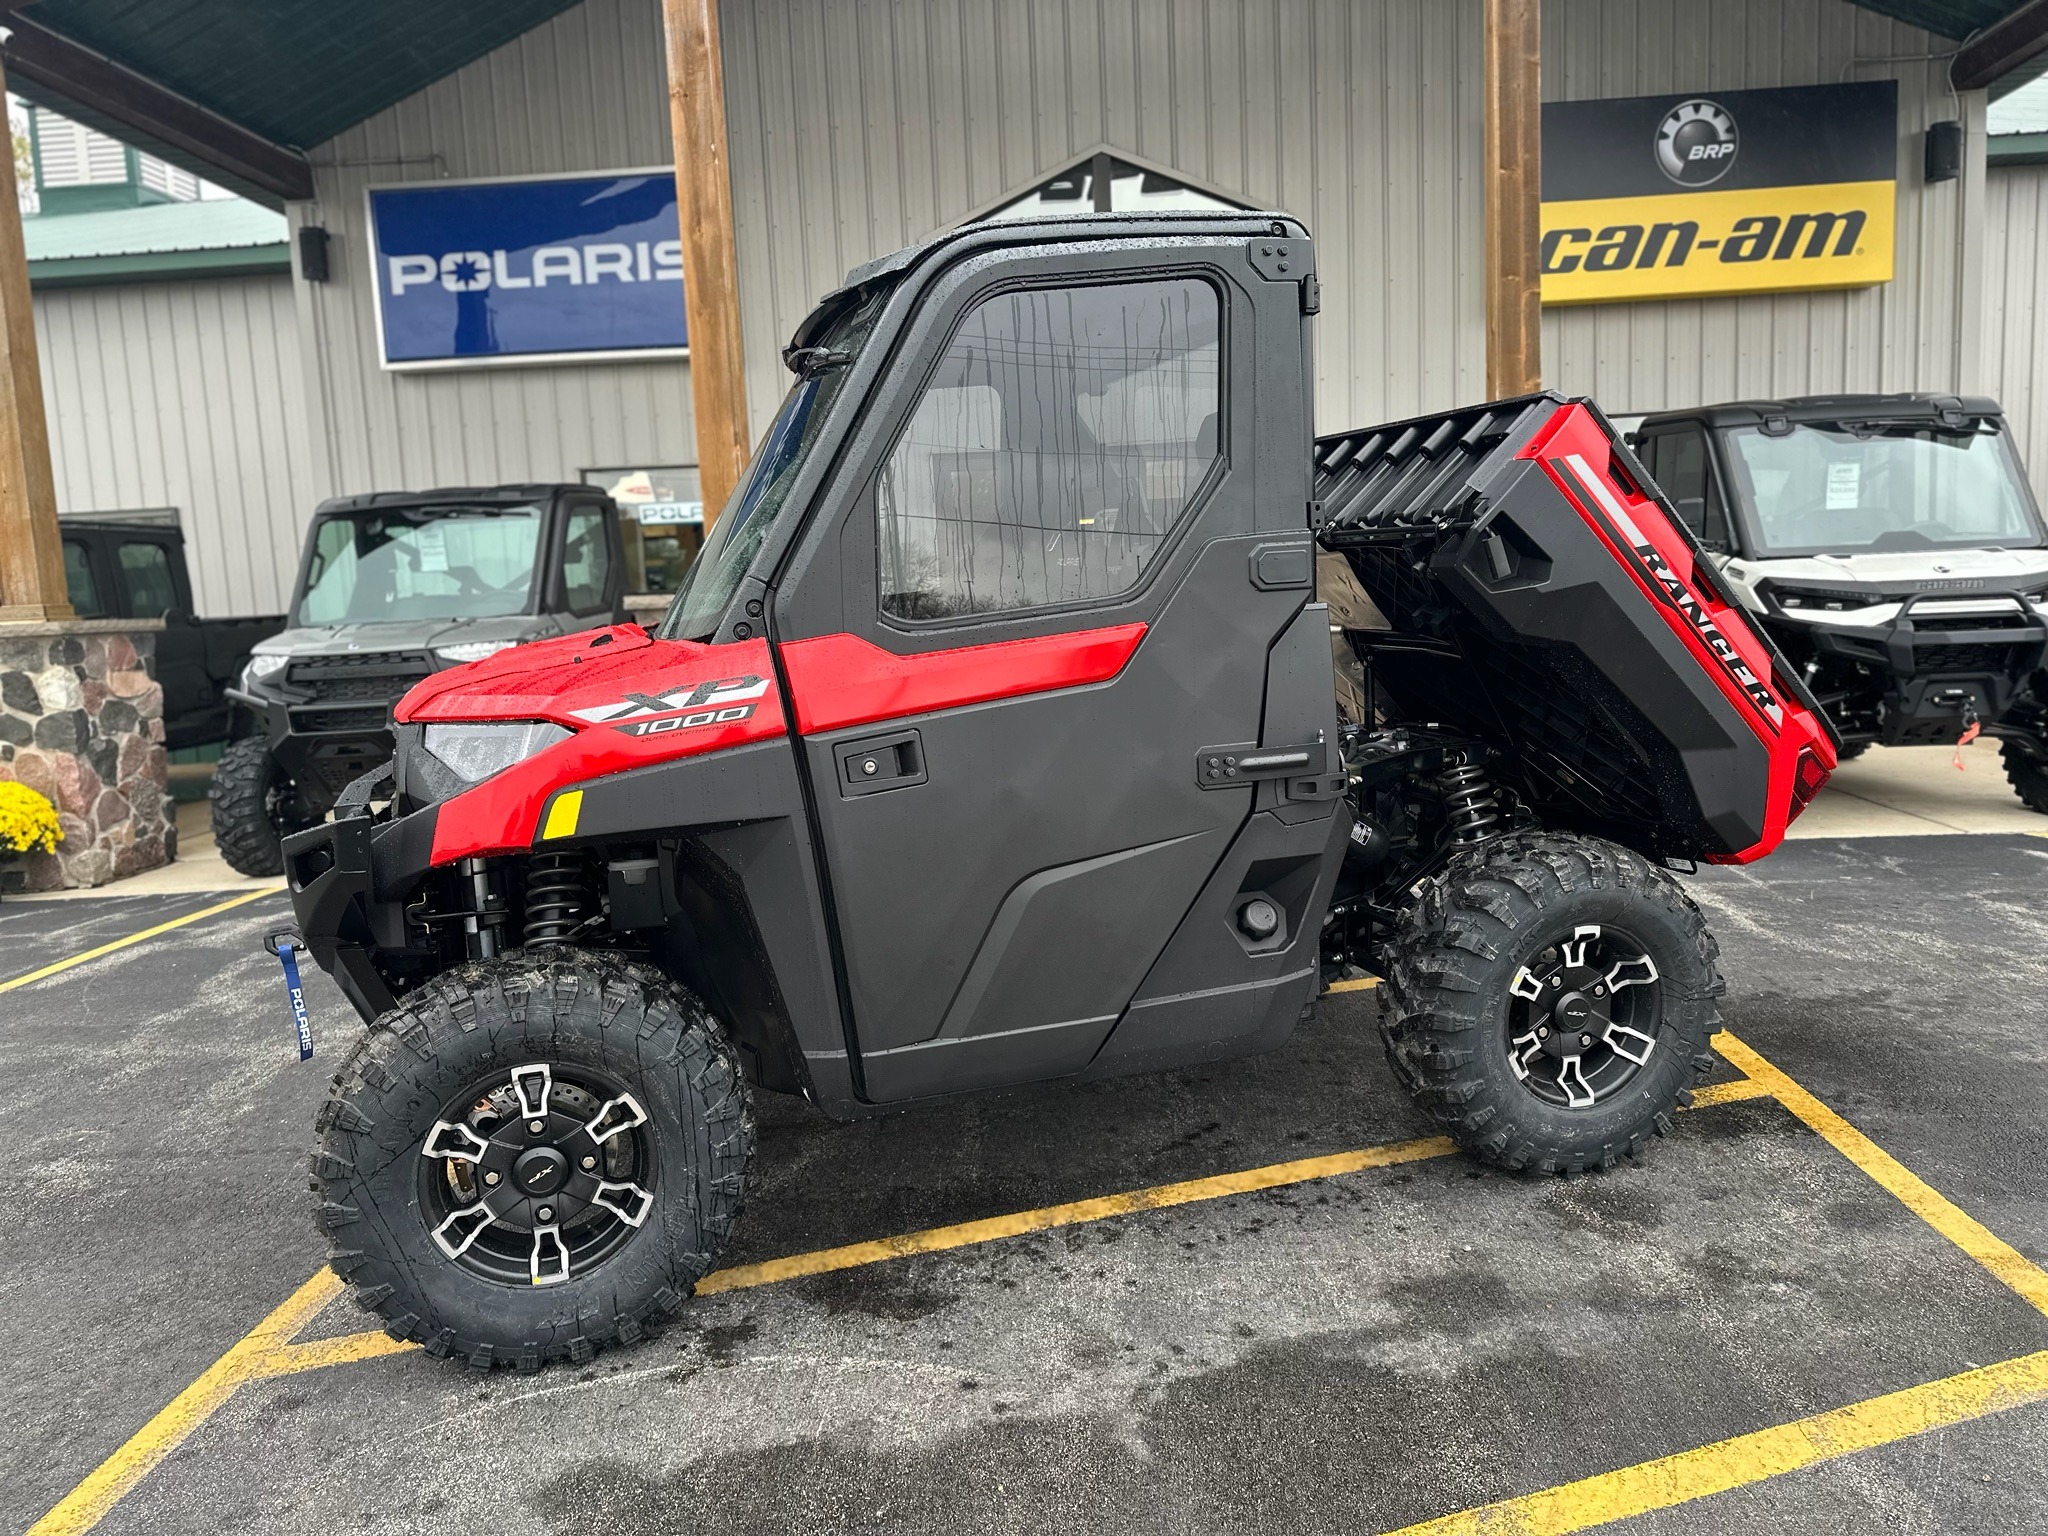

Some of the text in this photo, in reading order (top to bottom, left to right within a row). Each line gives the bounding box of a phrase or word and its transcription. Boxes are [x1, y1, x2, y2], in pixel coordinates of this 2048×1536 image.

[1687, 142, 1735, 161] BRP
[388, 240, 684, 296] POLARIS
[1634, 544, 1777, 709] RANGER
[600, 674, 765, 721] XP
[636, 706, 750, 736] 1000
[641, 720, 751, 743] DUAL OVERHEAD CAM
[290, 988, 312, 1051] POLARIS
